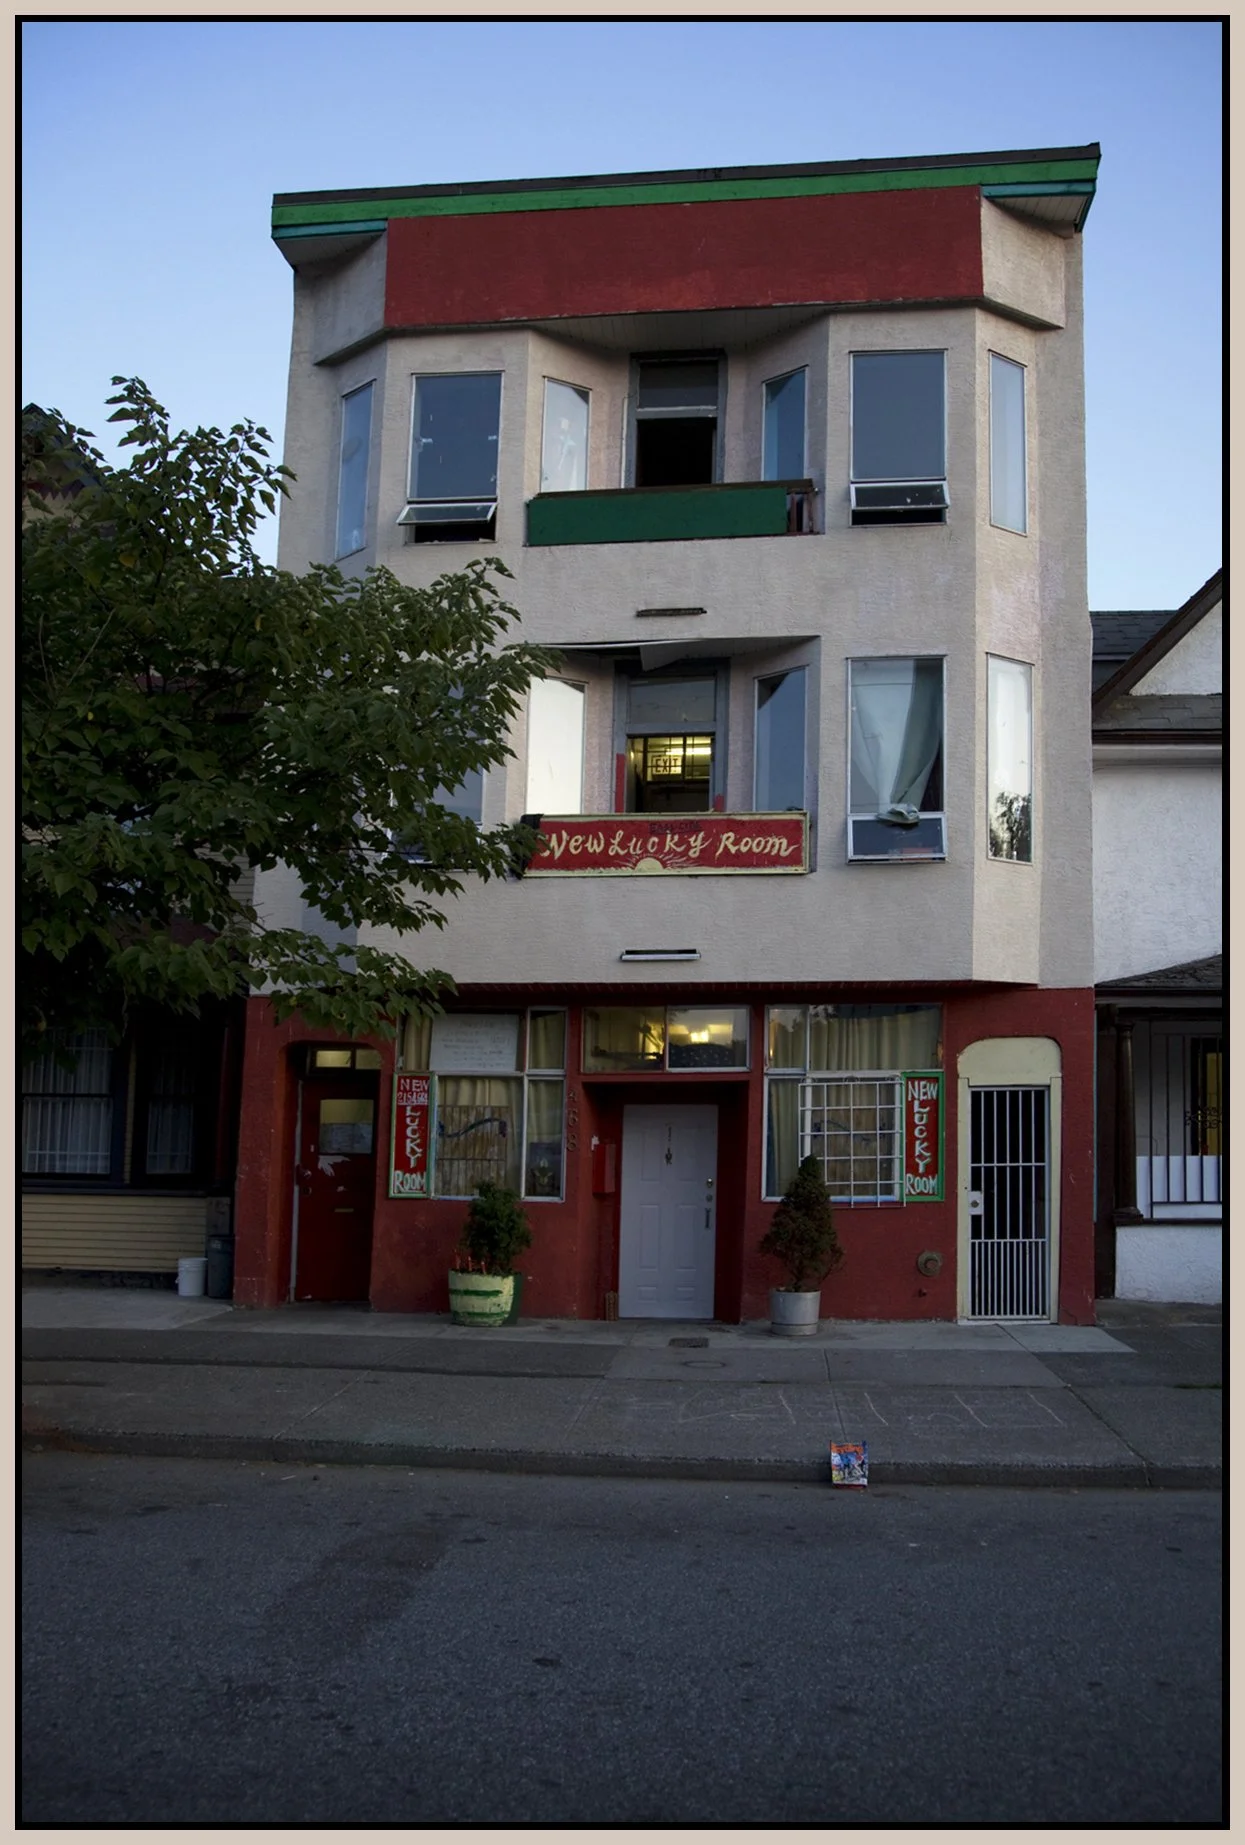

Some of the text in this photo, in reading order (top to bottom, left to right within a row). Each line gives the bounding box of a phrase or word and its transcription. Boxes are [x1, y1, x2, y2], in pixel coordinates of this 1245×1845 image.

[655, 758, 678, 773] EXIT
[540, 830, 604, 860] New
[715, 830, 800, 863] Room
[400, 1078, 430, 1092] NEW
[907, 1080, 938, 1101] NEW
[405, 1105, 423, 1168] LUCKY
[913, 1100, 931, 1173] LUCKY
[394, 1170, 426, 1193] ROOM
[905, 1174, 938, 1195] ROOM
